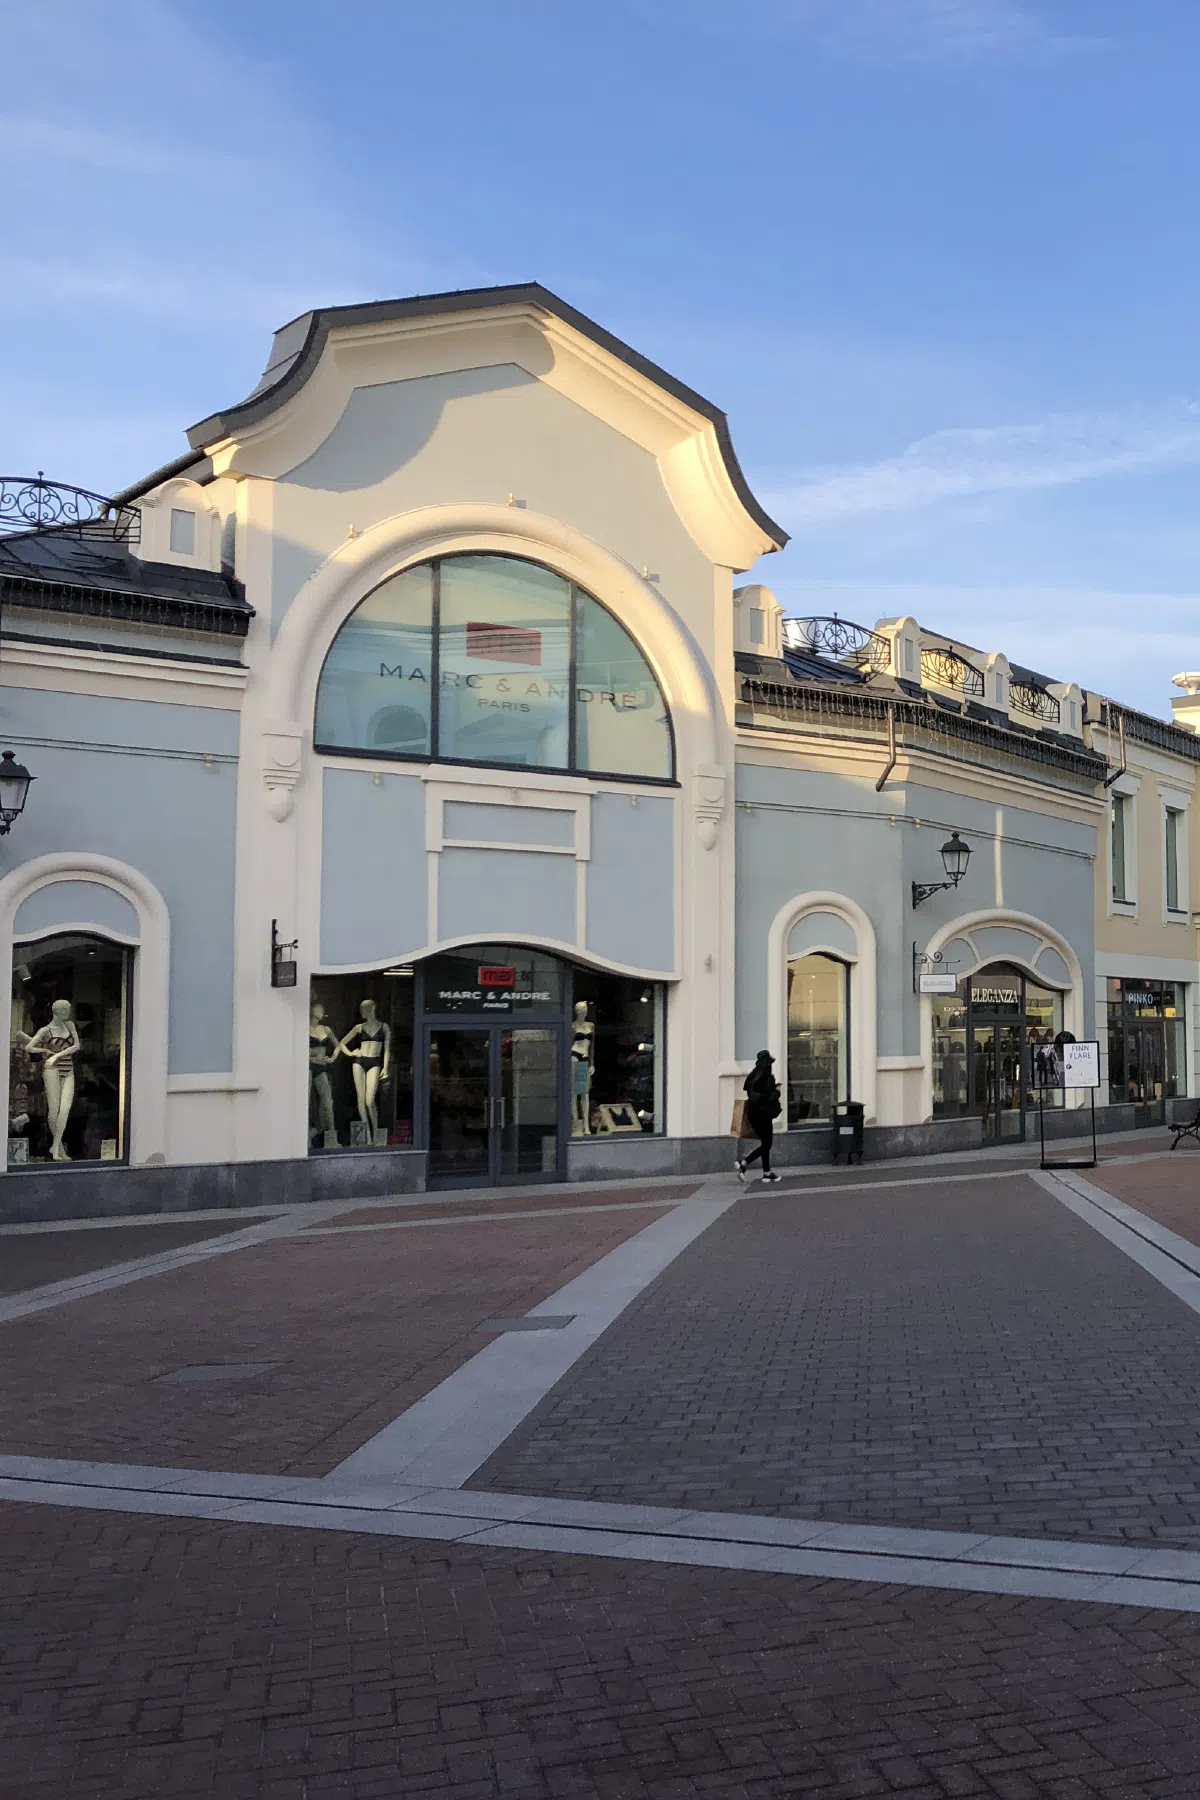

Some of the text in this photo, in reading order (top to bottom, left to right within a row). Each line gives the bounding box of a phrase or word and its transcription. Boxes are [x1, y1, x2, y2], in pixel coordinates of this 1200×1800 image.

[380, 662, 484, 689] MARC
[495, 677, 513, 693] &
[477, 698, 532, 713] PARIS
[439, 991, 482, 1000] MARC
[486, 991, 496, 1000] &
[971, 987, 1019, 1003] ELEGANZZA
[1127, 992, 1154, 1004] PINKO
[1069, 1052, 1092, 1060] FLARE
